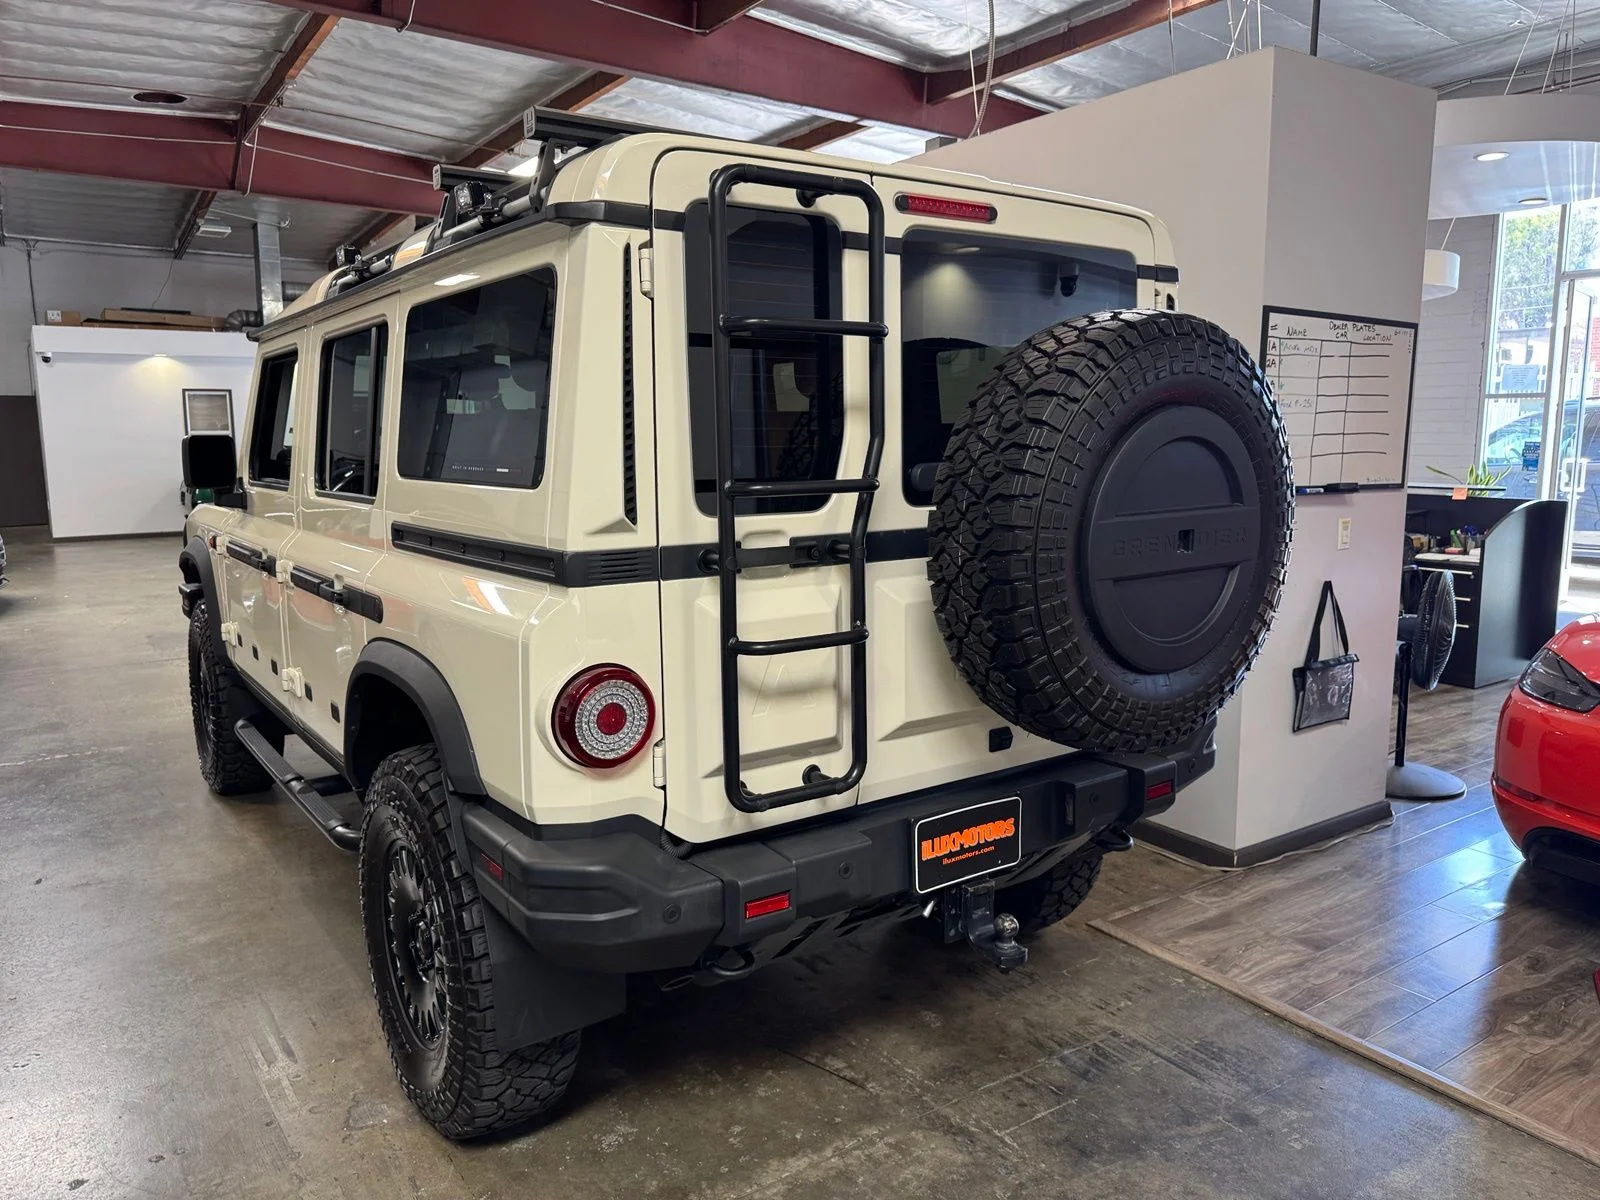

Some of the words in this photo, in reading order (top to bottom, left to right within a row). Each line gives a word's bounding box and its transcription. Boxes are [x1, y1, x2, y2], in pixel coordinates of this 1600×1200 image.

[1286, 326, 1308, 337] NAME
[1352, 323, 1376, 333] PLATES
[1335, 331, 1348, 340] CAR
[1363, 333, 1392, 342] LOCATION
[1268, 340, 1277, 352] 1A
[1266, 358, 1277, 368] 2A
[942, 845, 995, 865] iluxmotors.com
